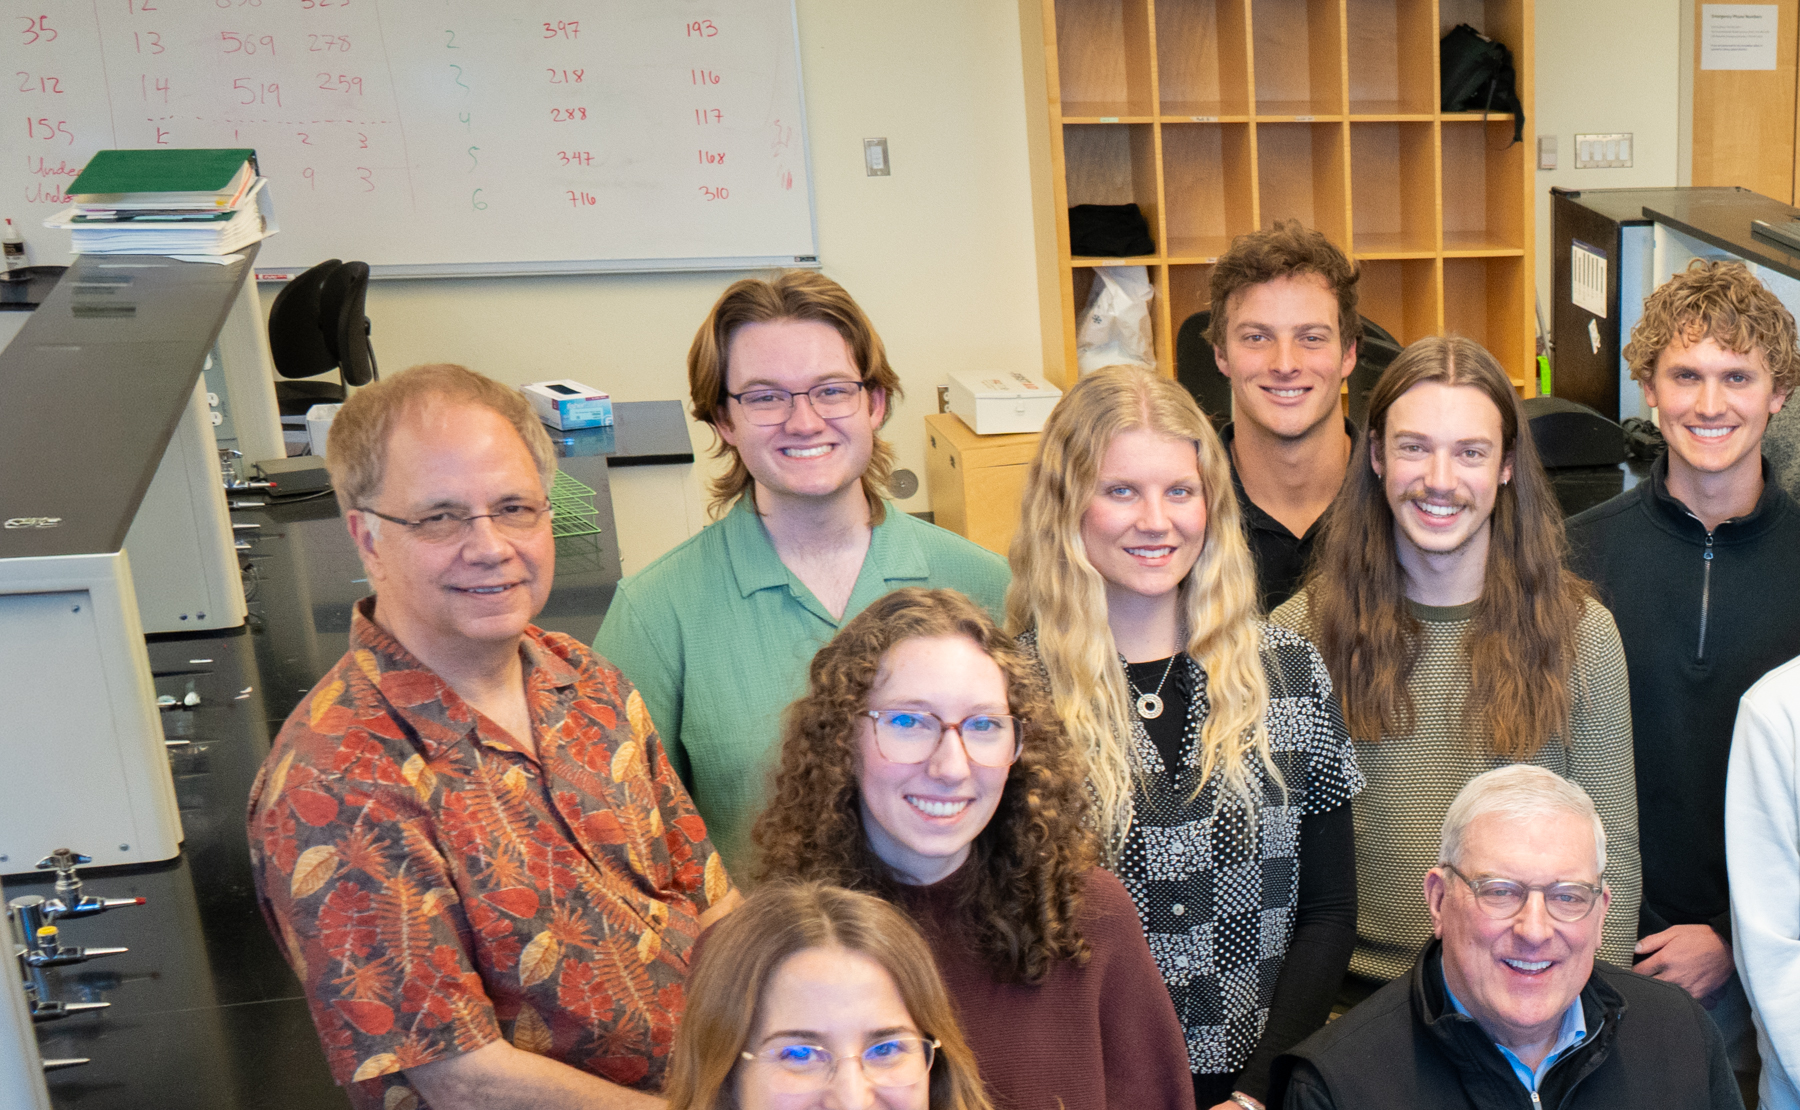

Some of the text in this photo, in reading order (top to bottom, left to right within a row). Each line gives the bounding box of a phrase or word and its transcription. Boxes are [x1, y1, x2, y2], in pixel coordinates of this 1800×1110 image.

[16, 15, 58, 45] 35
[445, 20, 719, 49] 2 397 193
[134, 31, 351, 56] 13 569 278
[16, 71, 64, 94] 212
[546, 68, 584, 84] 218
[692, 69, 720, 85] 116
[141, 73, 363, 108] 14 519 259
[551, 107, 588, 122] 288
[695, 108, 724, 126] 117
[27, 117, 75, 146] 155
[557, 151, 595, 166] 347
[698, 150, 726, 164] 168
[302, 167, 374, 192] 9 3
[472, 186, 729, 210] 6 716 310
